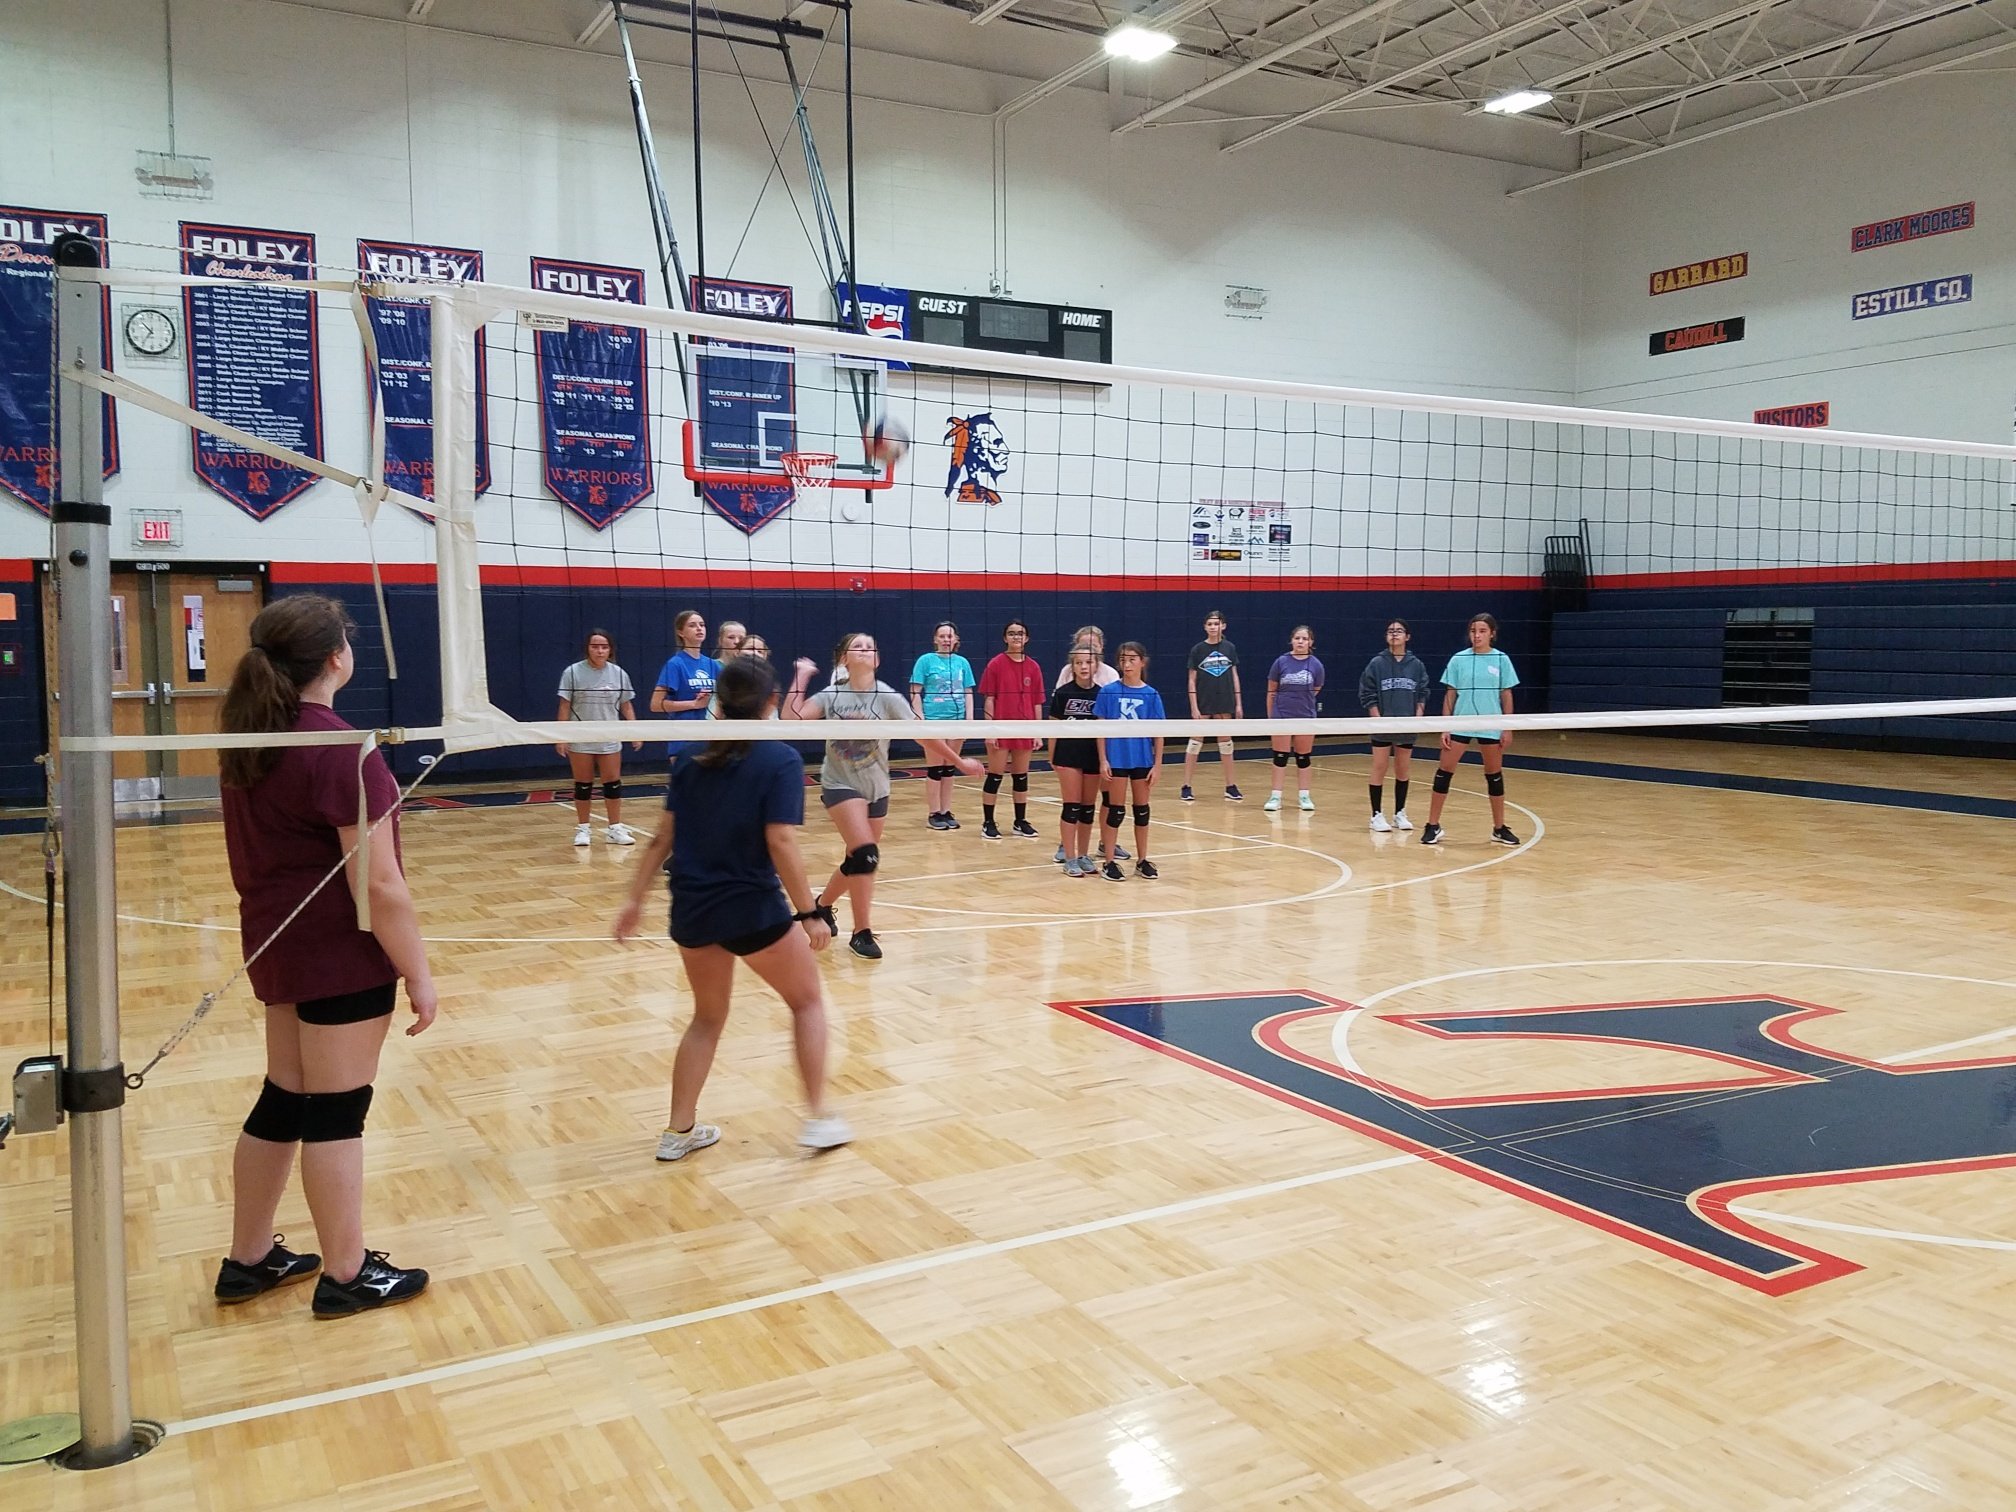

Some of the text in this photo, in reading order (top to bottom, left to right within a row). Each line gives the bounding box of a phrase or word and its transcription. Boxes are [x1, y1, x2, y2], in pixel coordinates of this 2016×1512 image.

[1856, 207, 1970, 248] CLARK MOORES
[193, 236, 300, 262] FOLEY
[371, 253, 469, 280] FOLEY
[542, 269, 633, 298] FOLEY
[704, 288, 782, 314] FOLEY
[919, 296, 968, 315] GUEST
[1855, 280, 1968, 317] ESTILL CO.
[842, 300, 905, 323] PEPSI
[1062, 311, 1102, 328] HOME
[385, 416, 426, 425] SEASONAL
[1757, 405, 1826, 428] VISITORS
[555, 429, 636, 441] SEASONAL CHAMPIONS
[711, 441, 784, 452] SEASONAL CHAPIONS
[202, 452, 297, 470] WARRIO
[551, 468, 643, 486] WARRIORS
[144, 521, 170, 539] EXIT
[1118, 698, 1144, 720] K
